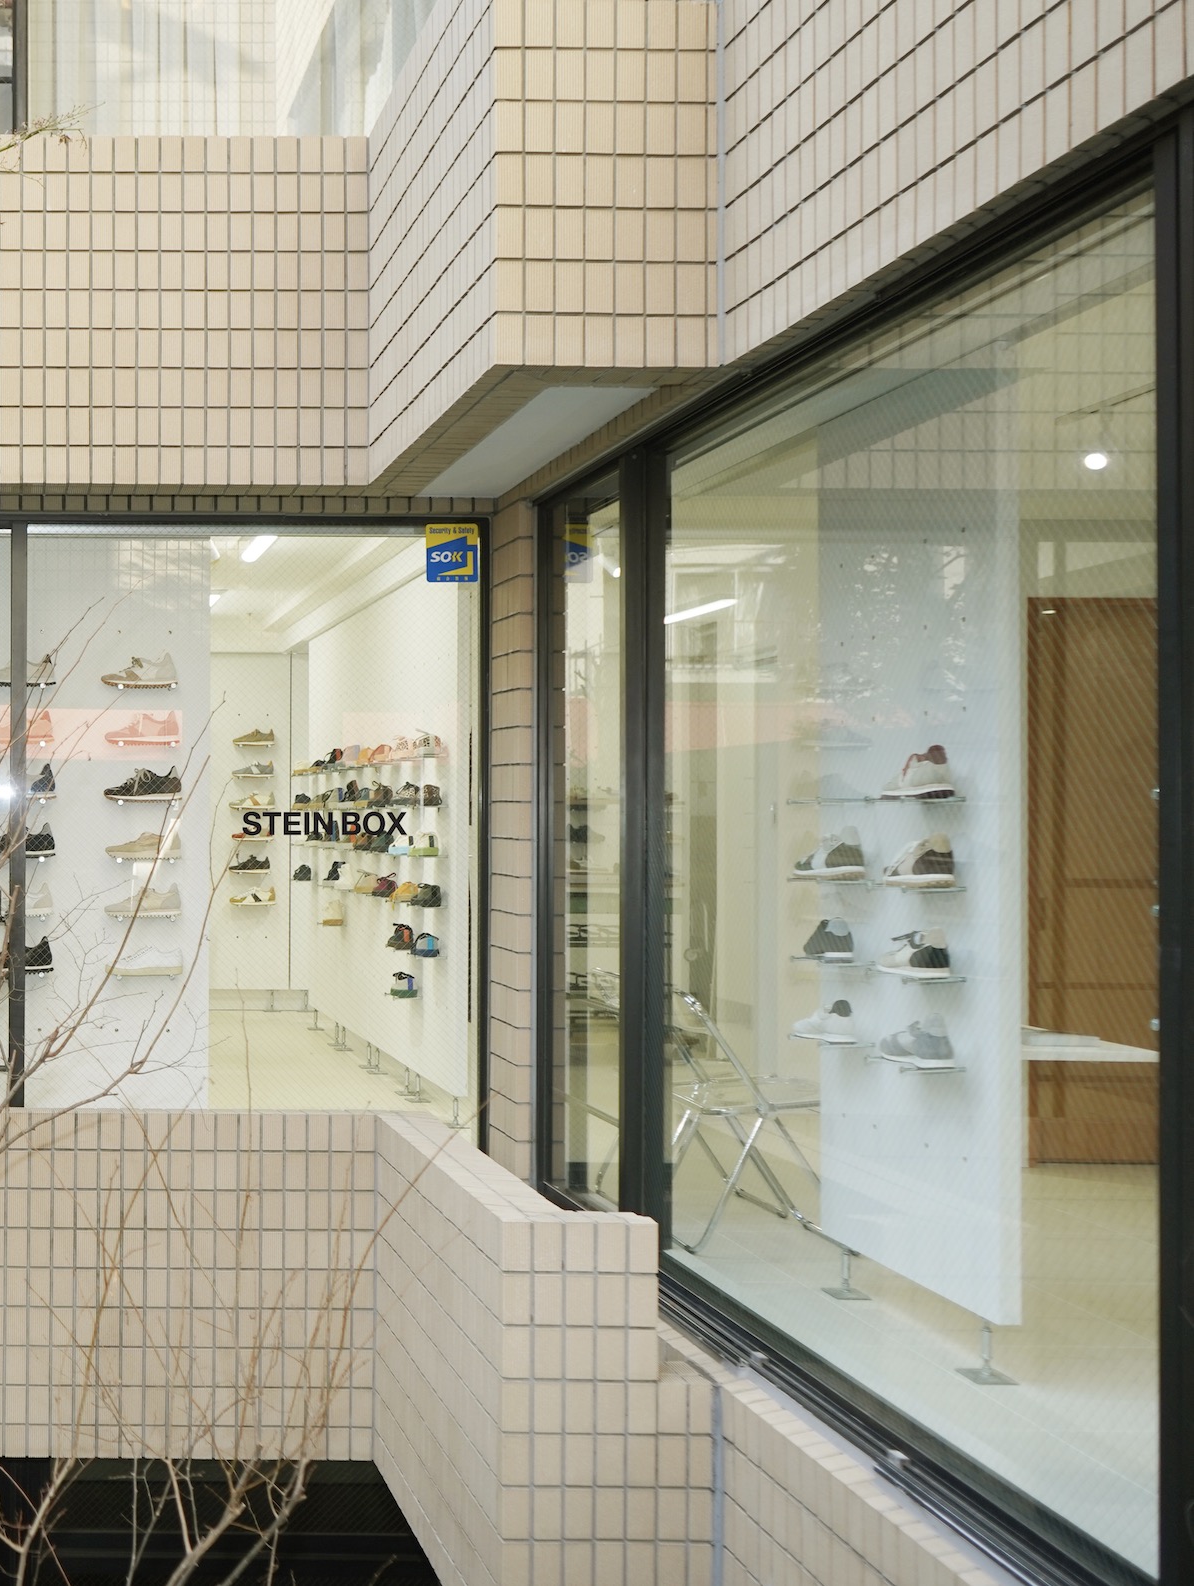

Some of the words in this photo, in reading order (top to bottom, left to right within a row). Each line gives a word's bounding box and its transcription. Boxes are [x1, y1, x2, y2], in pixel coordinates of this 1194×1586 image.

[430, 551, 463, 562] SOK
[242, 811, 333, 836] STEIN
[342, 811, 407, 836] BOX
